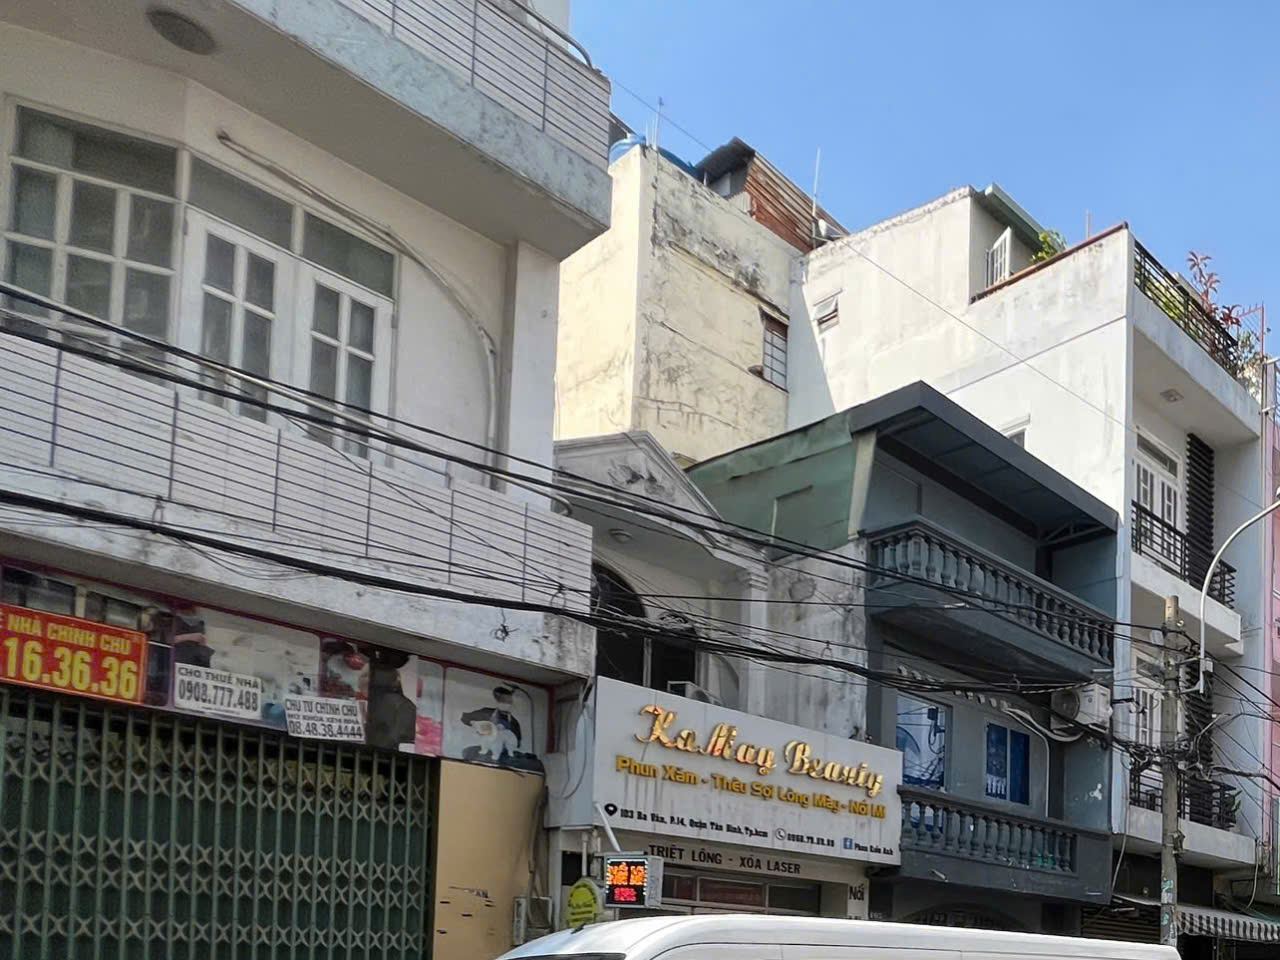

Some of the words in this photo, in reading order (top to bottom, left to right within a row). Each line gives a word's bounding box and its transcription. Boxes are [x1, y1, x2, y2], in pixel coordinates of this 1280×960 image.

[178, 667, 201, 678] CHO
[616, 754, 658, 778] Phun
[648, 844, 685, 861] TRIỆT
[691, 848, 722, 864] LÔNG
[767, 861, 801, 875] LASER
